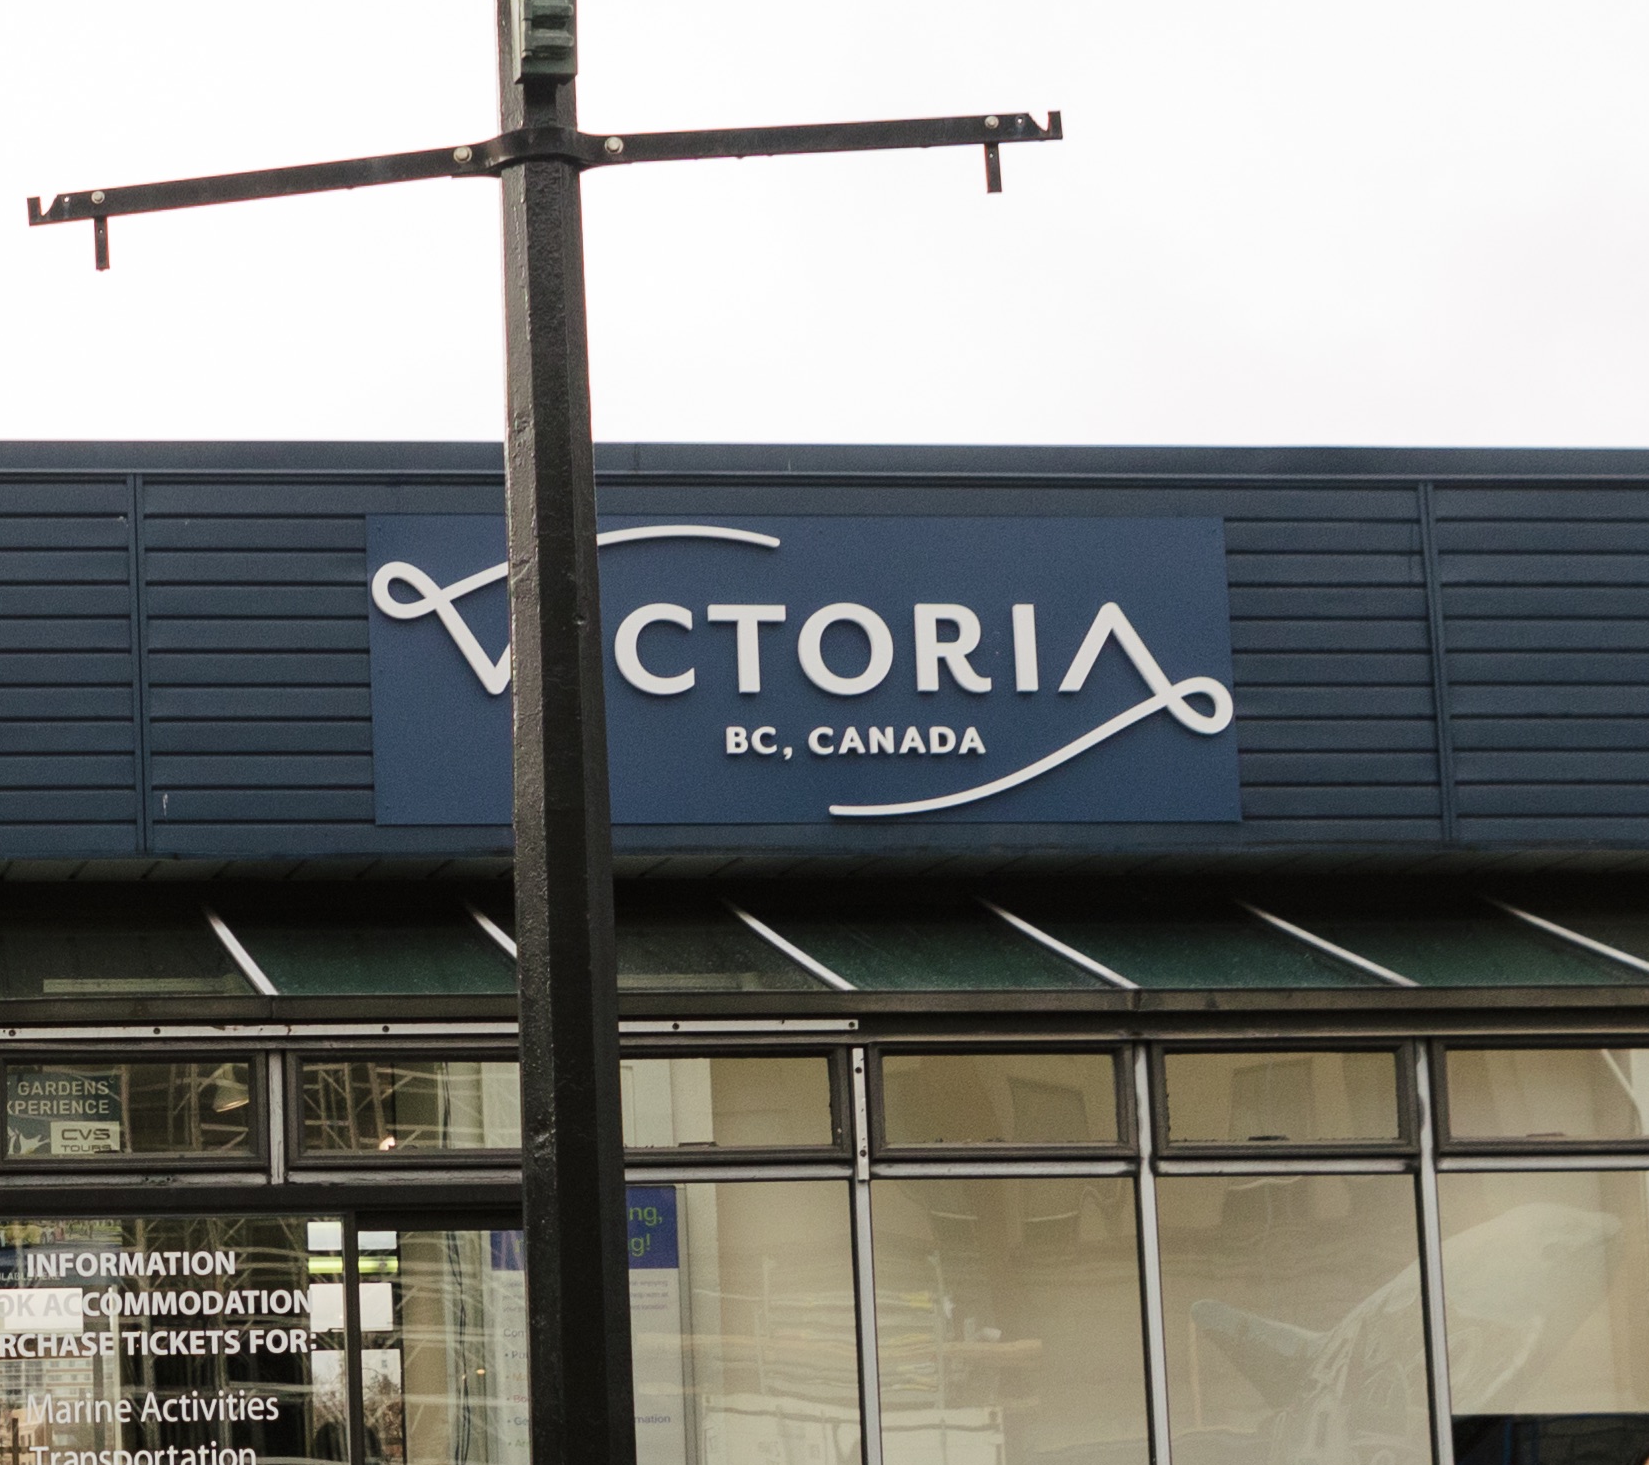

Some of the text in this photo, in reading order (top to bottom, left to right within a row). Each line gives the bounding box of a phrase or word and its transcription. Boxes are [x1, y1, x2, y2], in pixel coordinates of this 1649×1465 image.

[372, 561, 1233, 734] VCTORIA
[725, 725, 987, 761] BC, CANADA
[17, 1080, 110, 1096] GARDENS
[62, 1128, 110, 1141] CVS
[26, 1251, 236, 1277] INFORMATION
[43, 1289, 313, 1317] ACCOMMODATION
[122, 1329, 240, 1356] TICKETS
[250, 1328, 317, 1354] FOR:
[26, 1389, 280, 1424] Marine Activities
